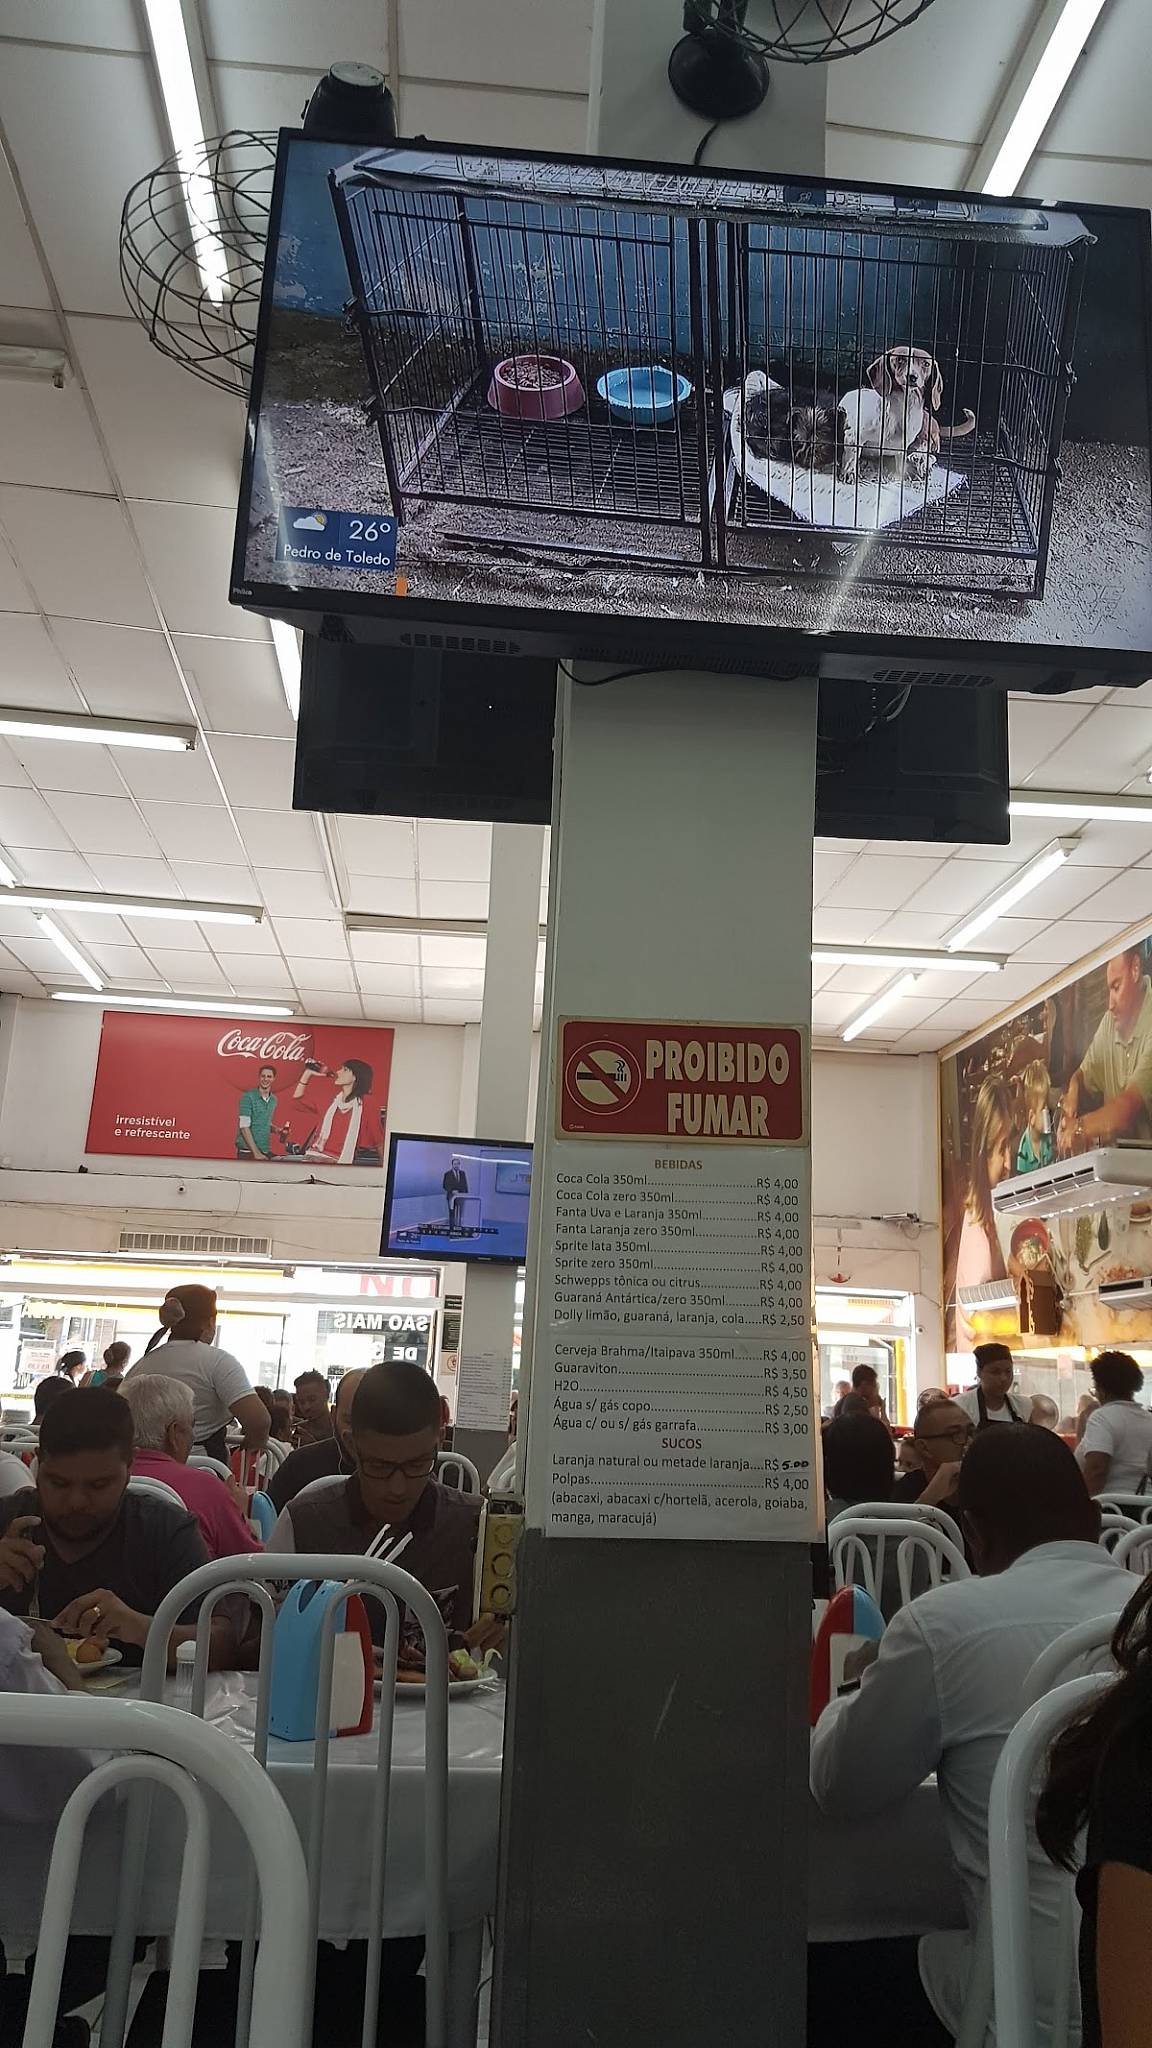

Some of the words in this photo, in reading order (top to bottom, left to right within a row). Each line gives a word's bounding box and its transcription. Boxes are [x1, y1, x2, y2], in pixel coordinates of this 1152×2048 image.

[349, 520, 391, 541] 26°
[284, 544, 321, 559] Pedro
[325, 548, 341, 561] de
[346, 550, 390, 566] Toledo
[645, 1040, 789, 1085] PROIBIDO
[116, 1115, 176, 1127] irresistível
[667, 1092, 769, 1136] FUMAR
[114, 1128, 121, 1136] e
[125, 1128, 190, 1140] refrescante
[654, 1159, 703, 1171] BEBIDAS
[556, 1172, 583, 1185] Coca
[585, 1173, 610, 1185] Cola
[613, 1174, 648, 1187] 350ml
[756, 1177, 771, 1189] R$
[774, 1178, 799, 1190] 4,00
[556, 1189, 583, 1201] Coca
[585, 1190, 610, 1202] Cola
[612, 1193, 637, 1203] zero
[639, 1191, 674, 1204] 350ml
[756, 1194, 771, 1206] R$
[774, 1195, 799, 1207] 4,00
[556, 1207, 587, 1218] Fanta
[590, 1207, 612, 1219] Uva
[614, 1210, 622, 1219] e
[624, 1208, 664, 1222] Laranja
[667, 1208, 702, 1220] 350ml
[756, 1211, 772, 1223] R$
[774, 1212, 800, 1224] 4,00
[556, 1223, 587, 1235] Fanta
[590, 1224, 630, 1238] Laranja
[633, 1227, 658, 1236] zero
[660, 1225, 696, 1237] 350ml
[757, 1227, 772, 1240] R$
[774, 1228, 800, 1241] 4,00
[555, 1240, 588, 1254] Sprite
[591, 1240, 612, 1252] lata
[615, 1241, 650, 1253] 350ml
[760, 1244, 775, 1257] R$
[778, 1245, 803, 1257] 4,00
[555, 1257, 588, 1271] Sprite
[591, 1260, 615, 1270] zero
[618, 1258, 654, 1271] 350ml
[760, 1261, 776, 1274] R$
[778, 1263, 804, 1275] 4,00
[554, 1274, 611, 1289] Schwepps
[614, 1274, 648, 1288] tônica
[651, 1278, 666, 1288] ou
[669, 1277, 701, 1289] citrus
[759, 1279, 774, 1291] R$
[777, 1280, 802, 1292] 4,00
[554, 1291, 602, 1303] Guaraná
[605, 1292, 687, 1306] Antártica/zero
[689, 1293, 726, 1306] 350ml
[760, 1296, 775, 1308] R$
[777, 1297, 803, 1309] 4,00
[554, 1308, 582, 1323] Dolly
[585, 1309, 620, 1323] limão,
[623, 1310, 673, 1324] guaraná,
[676, 1311, 718, 1325] laranja,
[721, 1313, 744, 1324] cola
[761, 1313, 777, 1326] R$
[779, 1314, 805, 1327] 2,50
[554, 1344, 597, 1358] Cerveja
[601, 1345, 696, 1360] Brahma/Itaipava
[698, 1347, 735, 1360] 350ml
[763, 1349, 778, 1362] R$
[780, 1350, 806, 1363] 4,00
[553, 1362, 618, 1374] Guaraviton
[763, 1367, 779, 1380] R$
[781, 1368, 807, 1380] 3,50
[554, 1379, 579, 1391] H2O
[764, 1385, 780, 1398] R$
[782, 1386, 808, 1399] 4,50
[553, 1396, 582, 1412] Água
[585, 1398, 597, 1412] s/
[599, 1399, 619, 1413] gás
[622, 1401, 651, 1413] copo
[765, 1404, 780, 1416] R$
[782, 1405, 809, 1417] 2,50
[553, 1415, 582, 1430] Água
[585, 1417, 597, 1430] c/
[599, 1419, 615, 1429] ou
[618, 1417, 631, 1431] s/
[633, 1418, 652, 1432] gás
[655, 1419, 697, 1432] garrafa
[764, 1422, 780, 1435] R$
[782, 1423, 809, 1436] 3,00
[661, 1437, 702, 1450] SUCOS
[552, 1453, 595, 1468] Laranja
[598, 1455, 640, 1468] natural
[643, 1458, 659, 1468] ou
[662, 1456, 706, 1469] metade
[709, 1458, 749, 1472] laranja
[764, 1458, 779, 1471] R$
[551, 1473, 590, 1488] Polpas
[764, 1477, 780, 1490] R$
[782, 1478, 809, 1491] 4,00
[551, 1492, 603, 1507] (abacaxi,
[606, 1493, 651, 1505] abacaxi
[653, 1494, 711, 1508] c/hortelã,
[714, 1495, 761, 1509] acerola,
[764, 1497, 808, 1511] goiaba,
[551, 1512, 595, 1525] manga,
[598, 1512, 657, 1527] maracujá)
